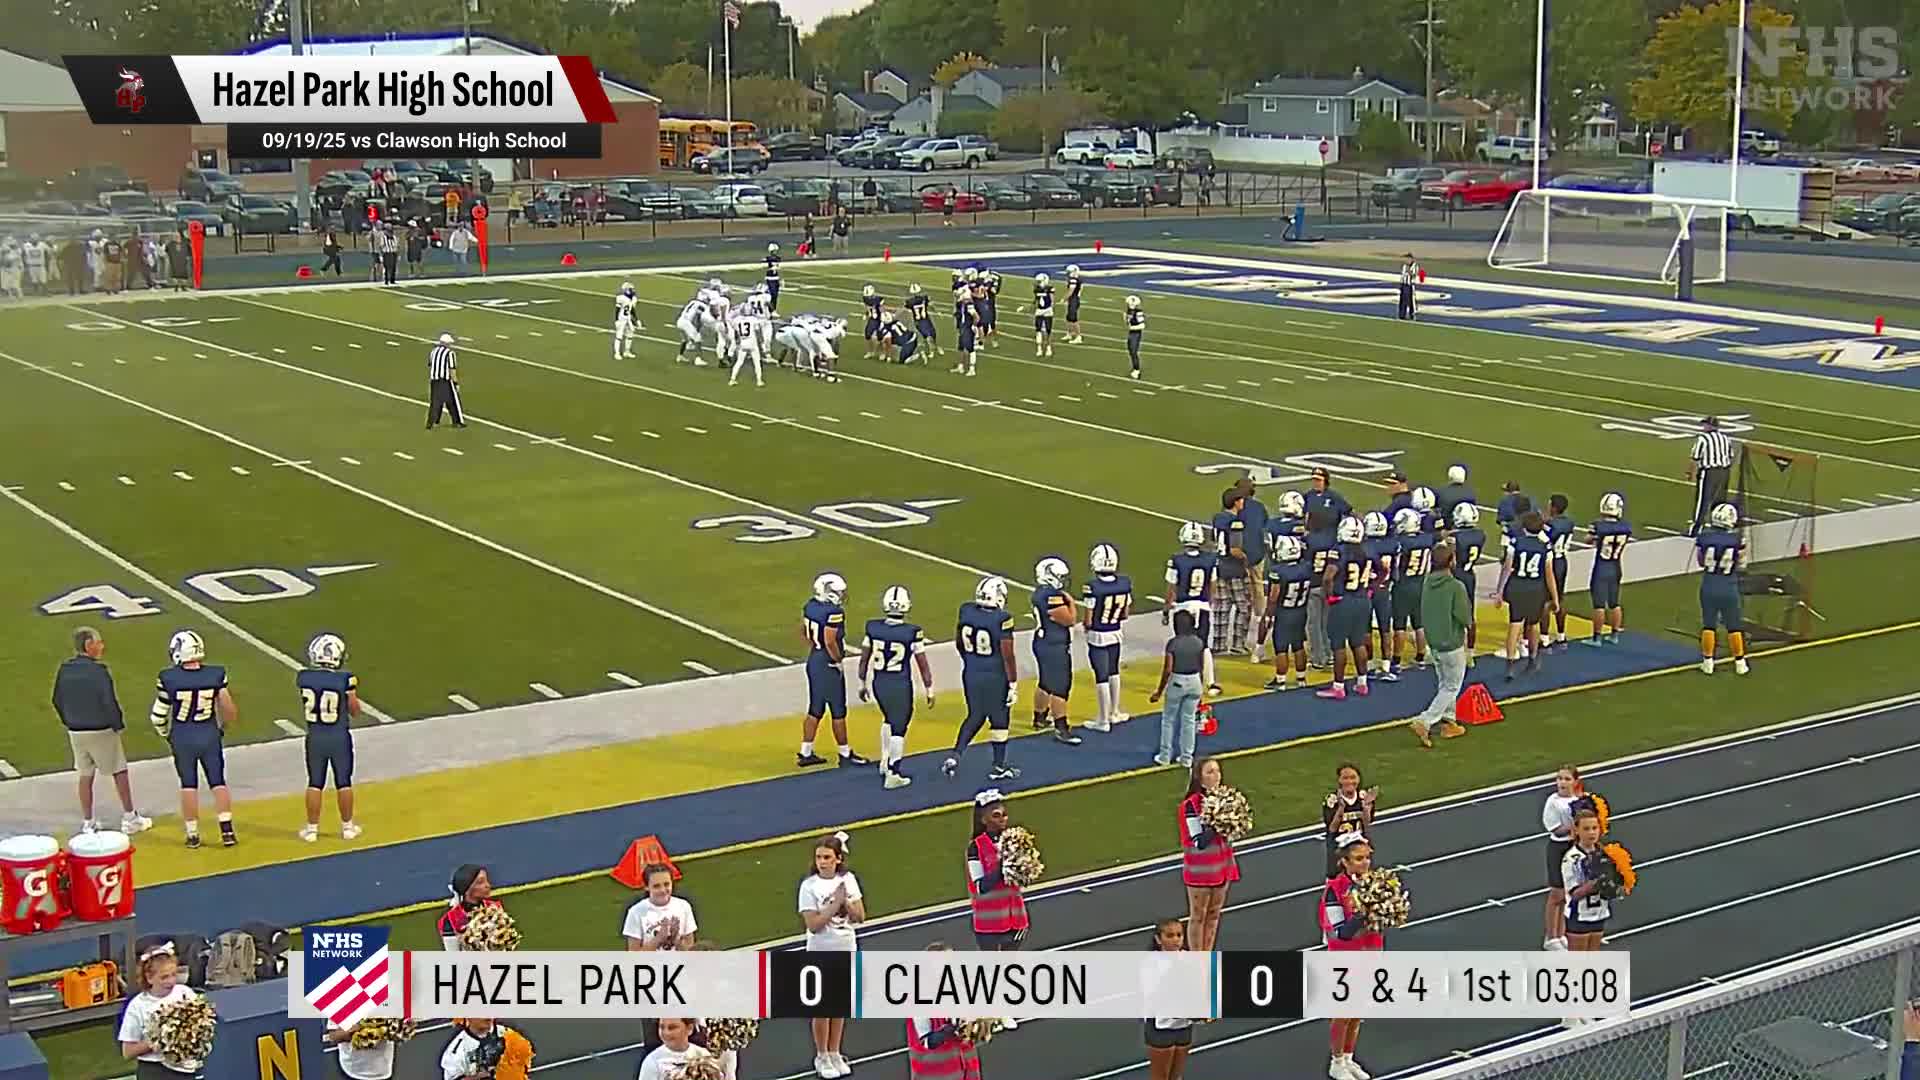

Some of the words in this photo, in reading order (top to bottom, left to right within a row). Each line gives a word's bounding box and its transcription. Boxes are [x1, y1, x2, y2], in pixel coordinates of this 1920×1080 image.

[738, 322, 751, 337] 13
[694, 502, 931, 542] 30
[1345, 559, 1373, 591] 34
[1518, 551, 1542, 578] 14
[1704, 546, 1735, 575] 44
[41, 567, 316, 619] 40
[1188, 568, 1206, 597] 9
[1100, 593, 1128, 625] 17
[961, 625, 993, 656] 68
[175, 689, 215, 722] 75
[302, 688, 339, 724] 20
[23, 868, 49, 897] G
[99, 864, 121, 888] G
